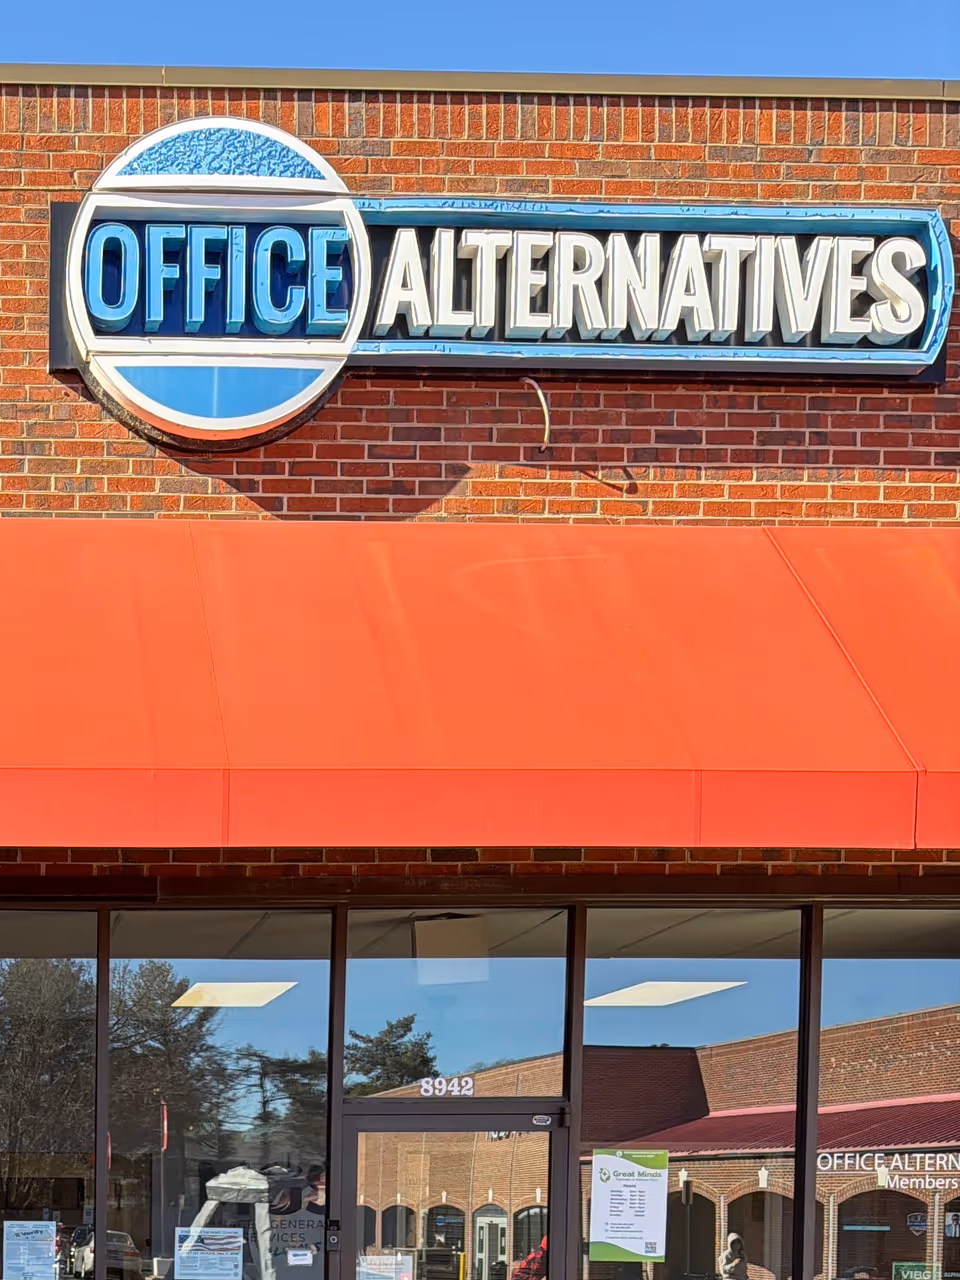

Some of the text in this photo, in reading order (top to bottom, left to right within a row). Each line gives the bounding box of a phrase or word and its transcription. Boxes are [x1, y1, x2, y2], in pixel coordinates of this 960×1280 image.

[84, 220, 928, 346] OFFICE ALTERNATIVES
[420, 1076, 474, 1097] 8942
[816, 1153, 885, 1171] OFFICE
[612, 1170, 662, 1178] Great Minds
[884, 1174, 959, 1190] Members
